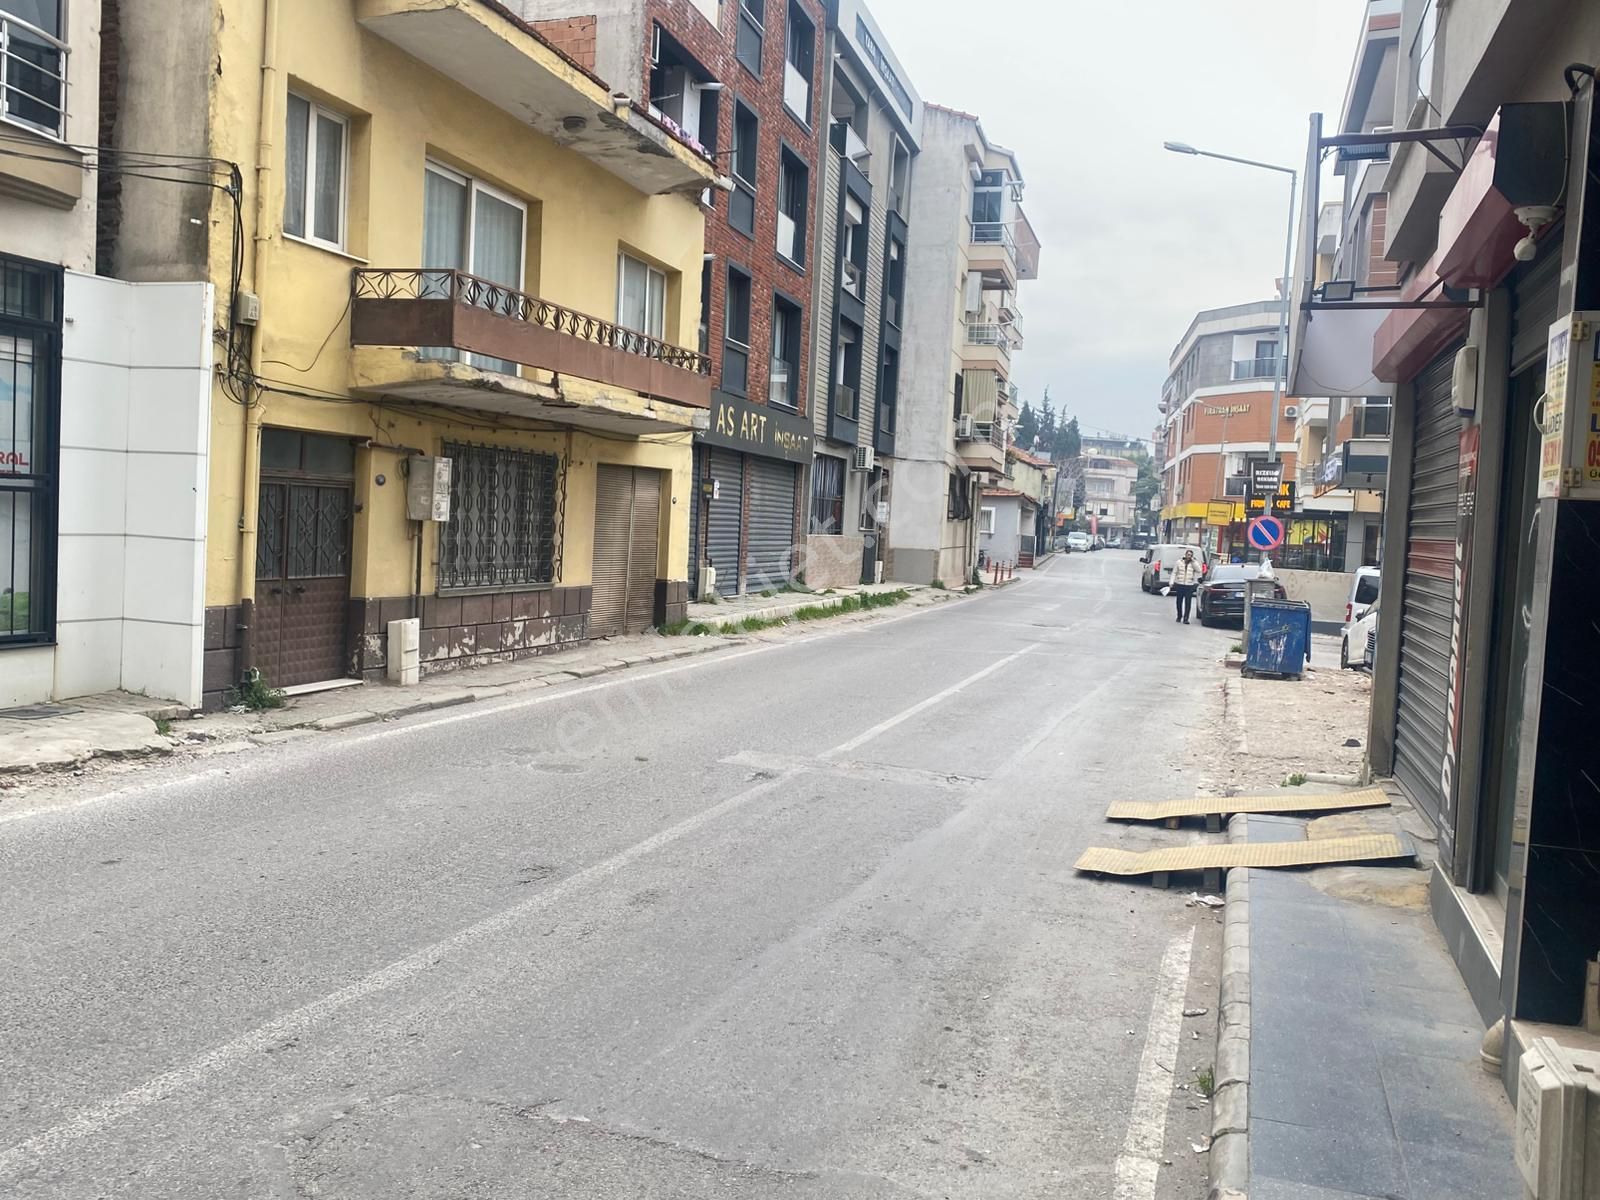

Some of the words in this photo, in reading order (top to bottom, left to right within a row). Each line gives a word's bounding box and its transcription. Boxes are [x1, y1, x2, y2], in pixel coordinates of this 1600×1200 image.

[715, 403, 736, 437] AS
[740, 410, 767, 443] ART
[1276, 499, 1291, 509] CAFE
